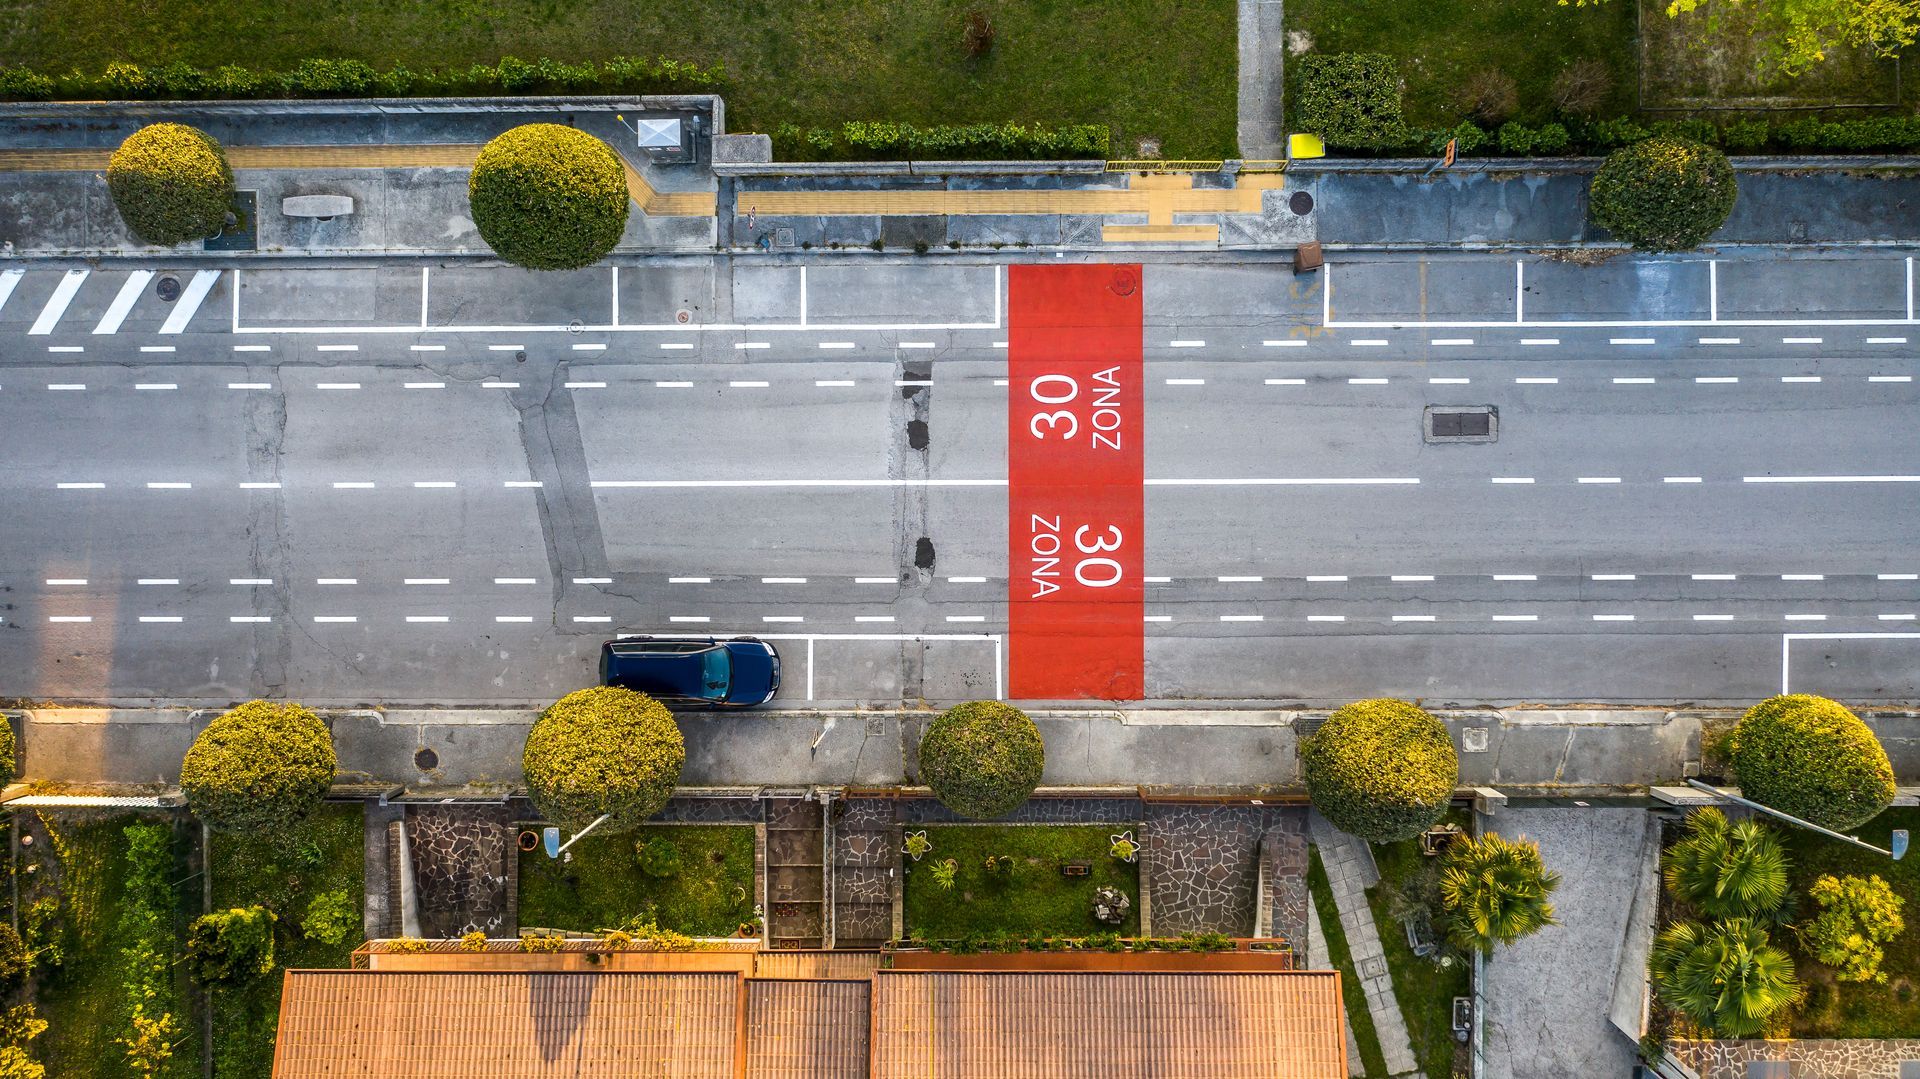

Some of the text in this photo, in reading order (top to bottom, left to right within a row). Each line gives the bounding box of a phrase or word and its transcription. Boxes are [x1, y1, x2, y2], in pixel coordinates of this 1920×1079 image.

[1031, 374, 1079, 439] 30
[1091, 365, 1121, 450] ZONA
[1031, 514, 1061, 598] ZONA
[1074, 525, 1123, 587] 30
